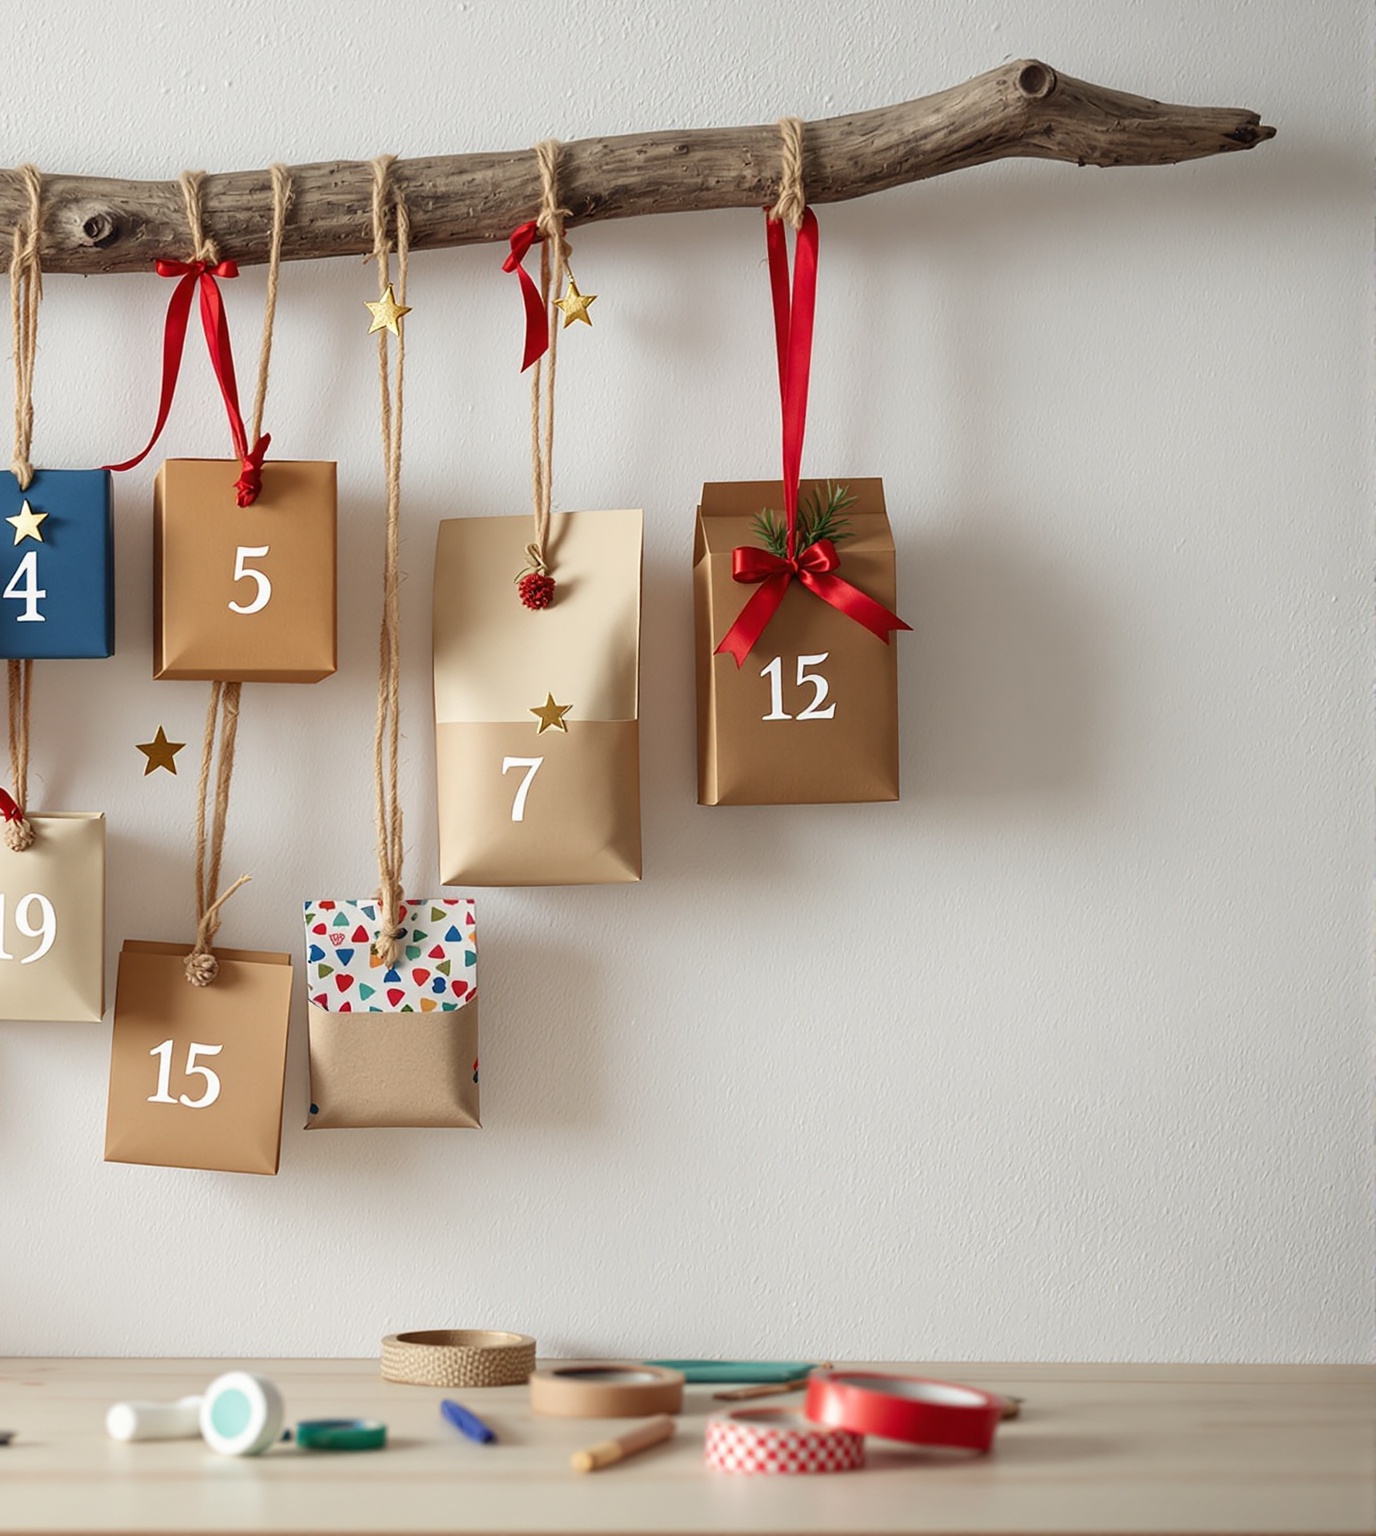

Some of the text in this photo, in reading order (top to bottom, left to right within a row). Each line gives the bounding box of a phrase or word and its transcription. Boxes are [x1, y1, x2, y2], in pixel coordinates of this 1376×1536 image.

[2, 551, 46, 622] 4
[228, 545, 272, 614] 5
[502, 756, 544, 822] 7
[147, 1039, 224, 1108] 15
